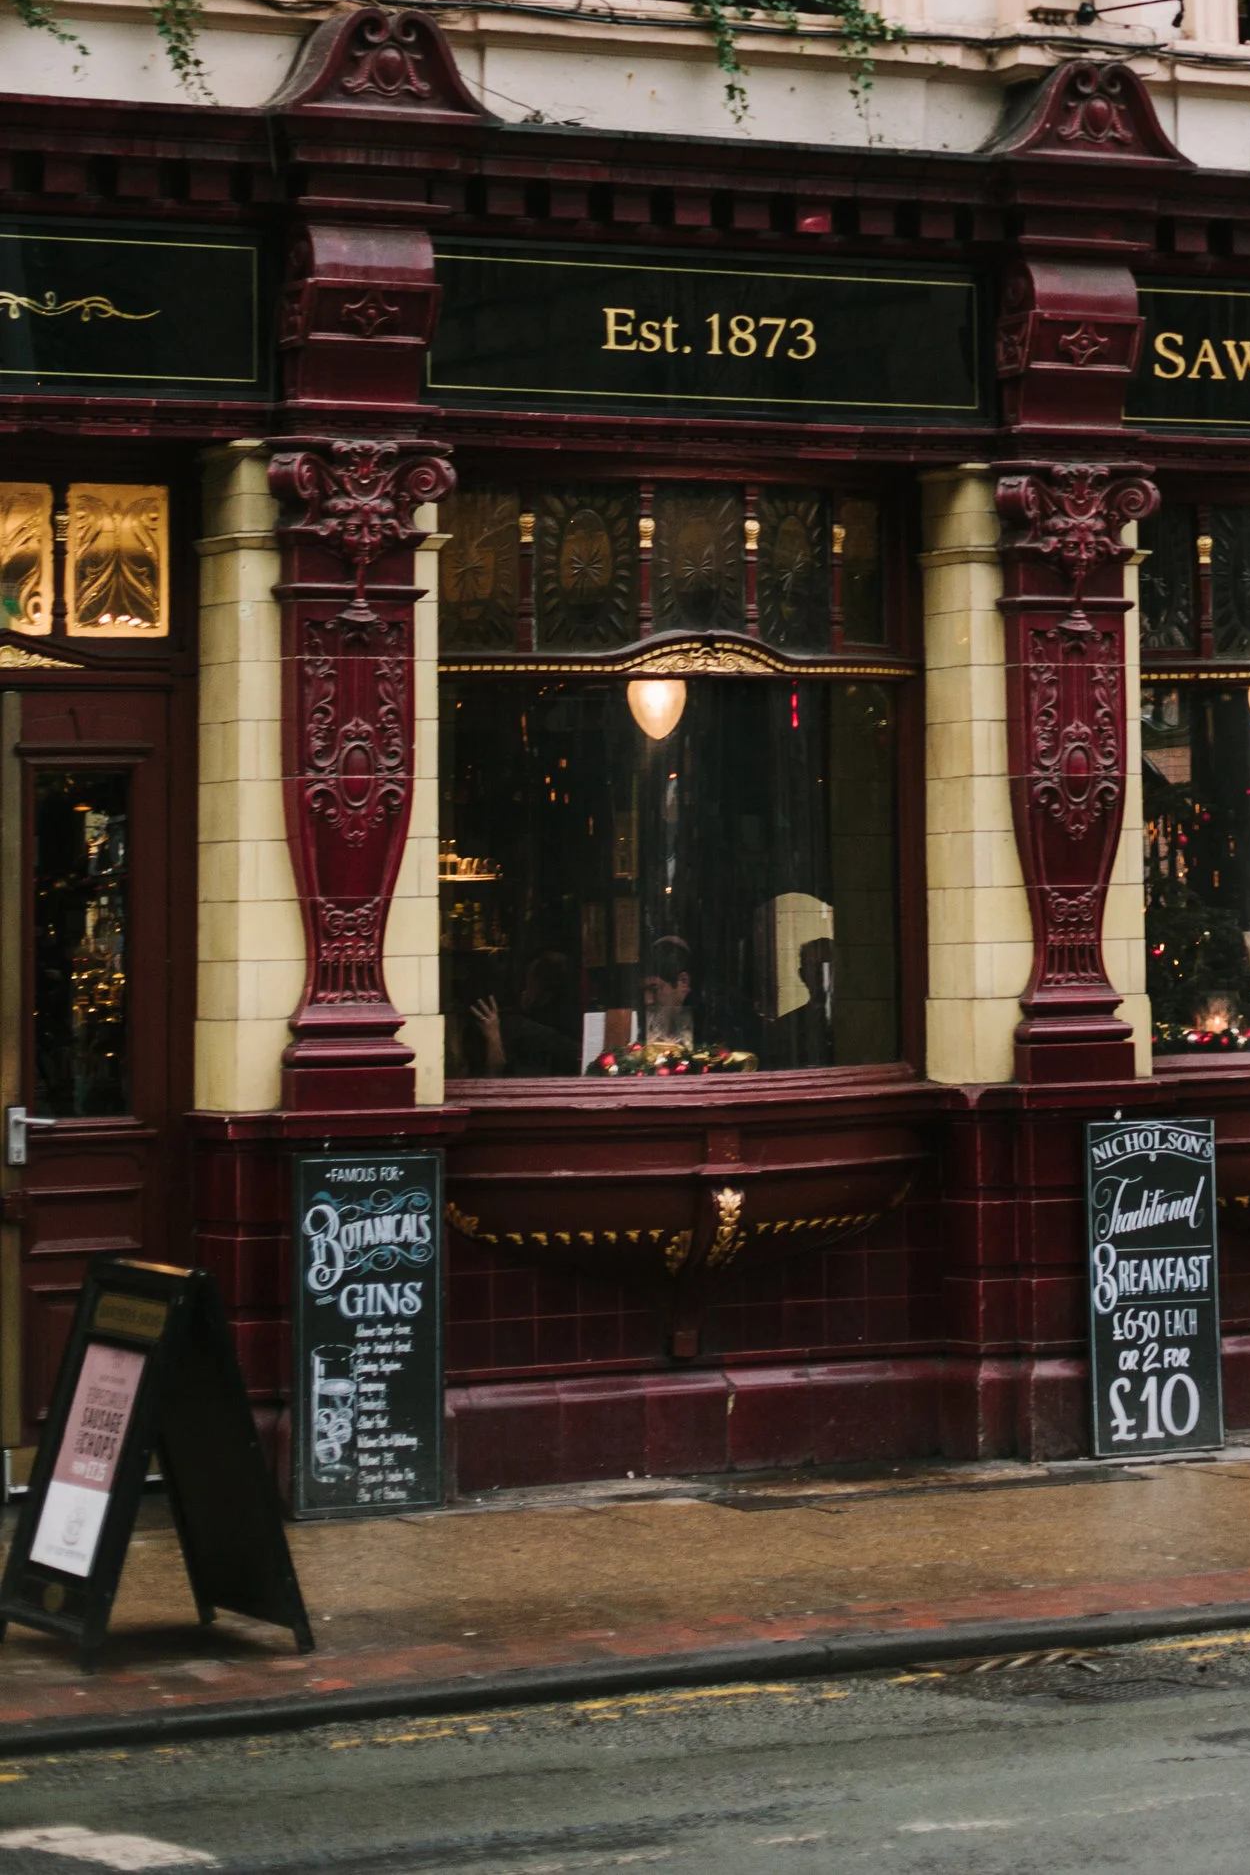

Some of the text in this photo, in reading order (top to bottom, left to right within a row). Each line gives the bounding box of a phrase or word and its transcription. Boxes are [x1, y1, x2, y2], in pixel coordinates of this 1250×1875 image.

[601, 307, 817, 360] Est. 1873
[1092, 1130, 1213, 1164] NICHOLSON'S
[330, 1166, 400, 1183] FAMOUS FOR
[1092, 1175, 1205, 1242] Traditional
[301, 1204, 432, 1292] BOTANICALS
[338, 1281, 424, 1318] GINS
[1093, 1242, 1212, 1315] BREAKFAST
[1164, 1308, 1198, 1338] EACH
[1118, 1342, 1191, 1373] OR 2 FOR
[1109, 1373, 1200, 1442] £10
